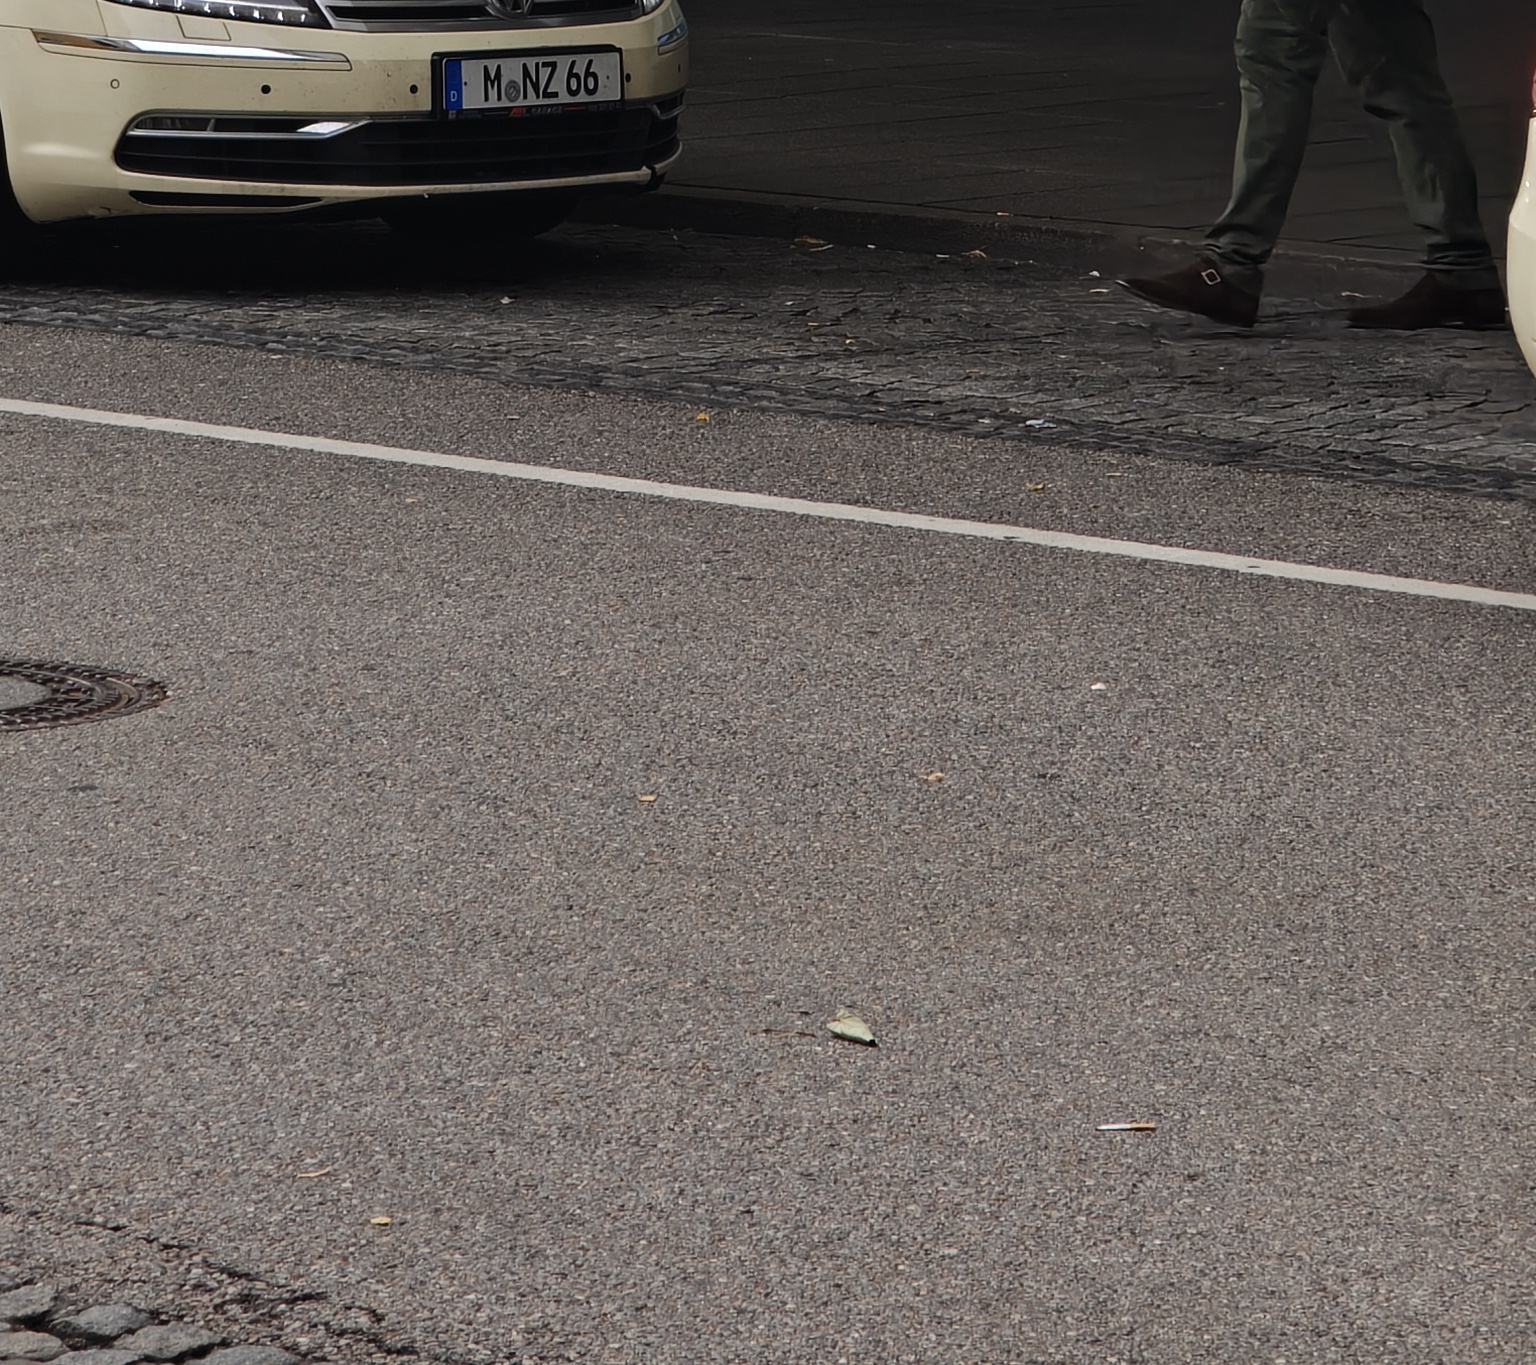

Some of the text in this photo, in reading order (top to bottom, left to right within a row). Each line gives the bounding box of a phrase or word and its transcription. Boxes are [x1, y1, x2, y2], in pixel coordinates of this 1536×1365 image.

[483, 64, 501, 102] M
[522, 60, 558, 100] NZ
[566, 58, 598, 97] 66
